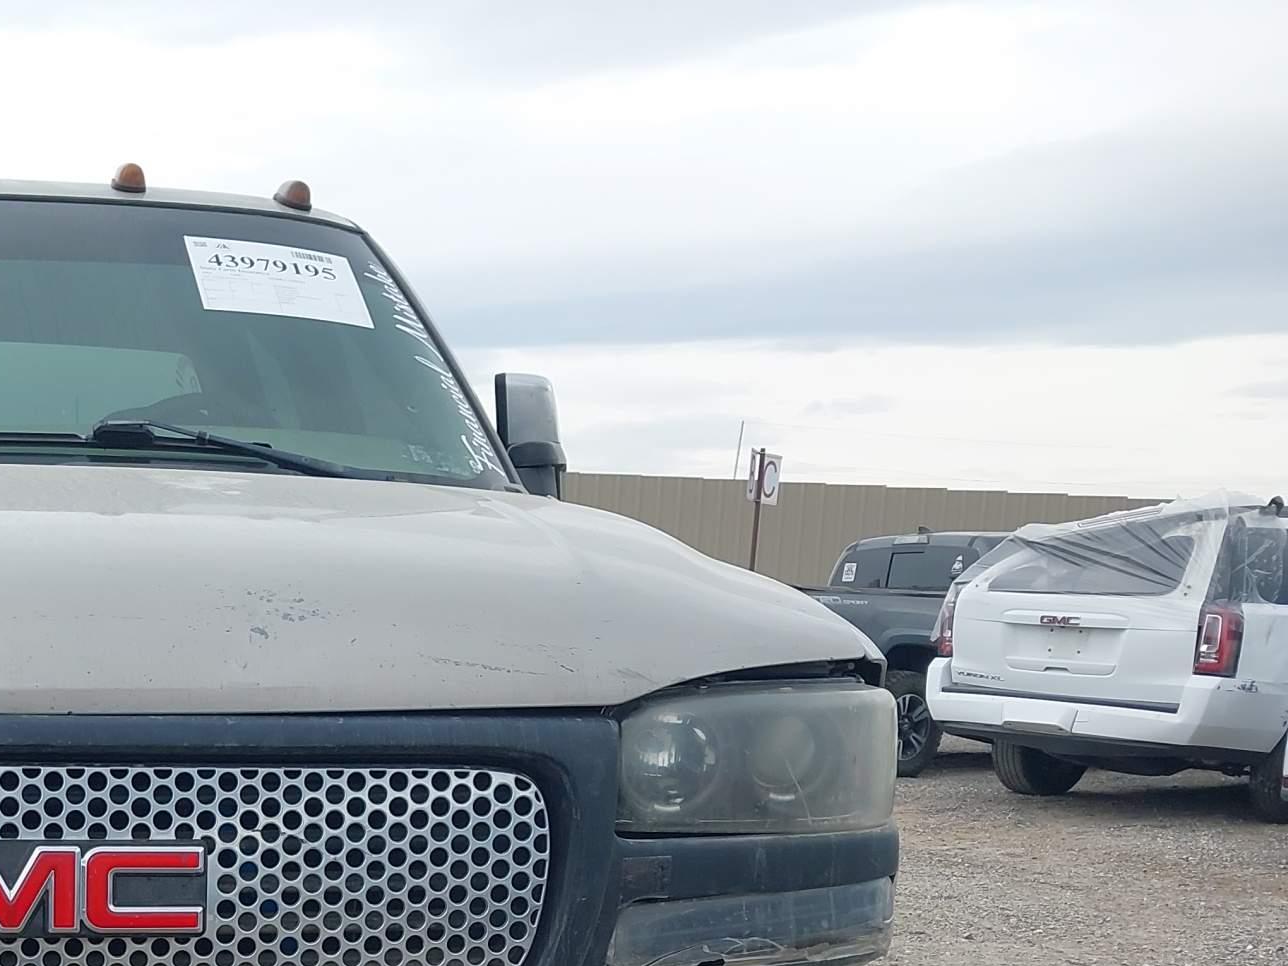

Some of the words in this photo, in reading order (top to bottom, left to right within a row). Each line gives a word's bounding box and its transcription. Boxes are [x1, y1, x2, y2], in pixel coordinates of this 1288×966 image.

[208, 253, 337, 281] 43979195
[763, 460, 777, 498] C
[1039, 615, 1082, 626] GMC
